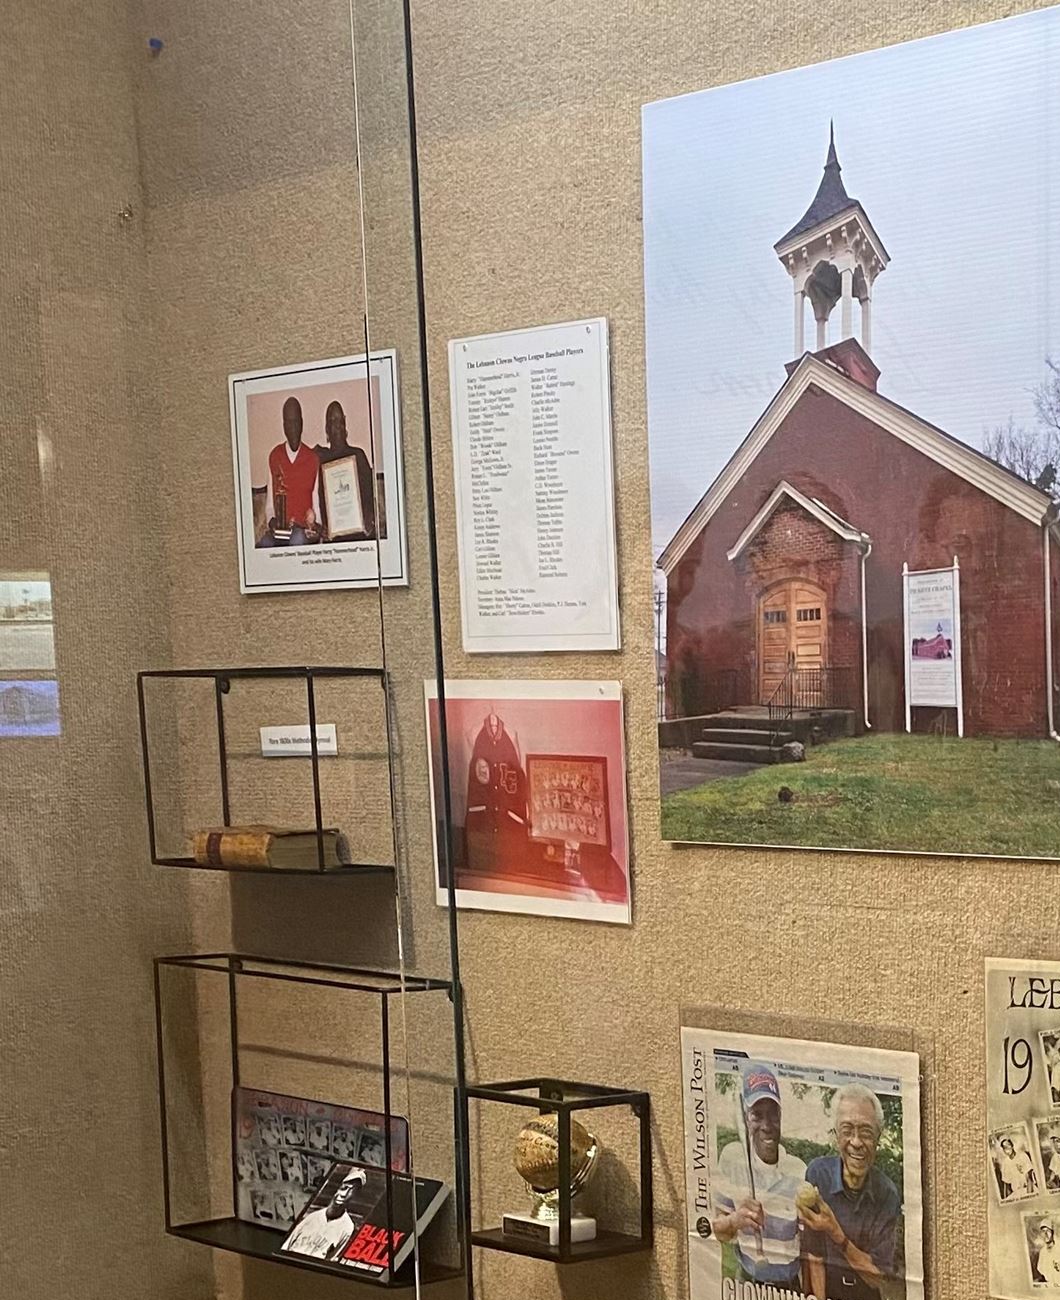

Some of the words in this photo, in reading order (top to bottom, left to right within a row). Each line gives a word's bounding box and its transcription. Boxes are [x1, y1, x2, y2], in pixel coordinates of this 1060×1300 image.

[476, 360, 495, 368] Lebanon
[690, 1047, 704, 1092] POST
[1002, 1037, 1033, 1095] 19
[693, 1099, 706, 1171] WILSON
[695, 1177, 708, 1213] THE
